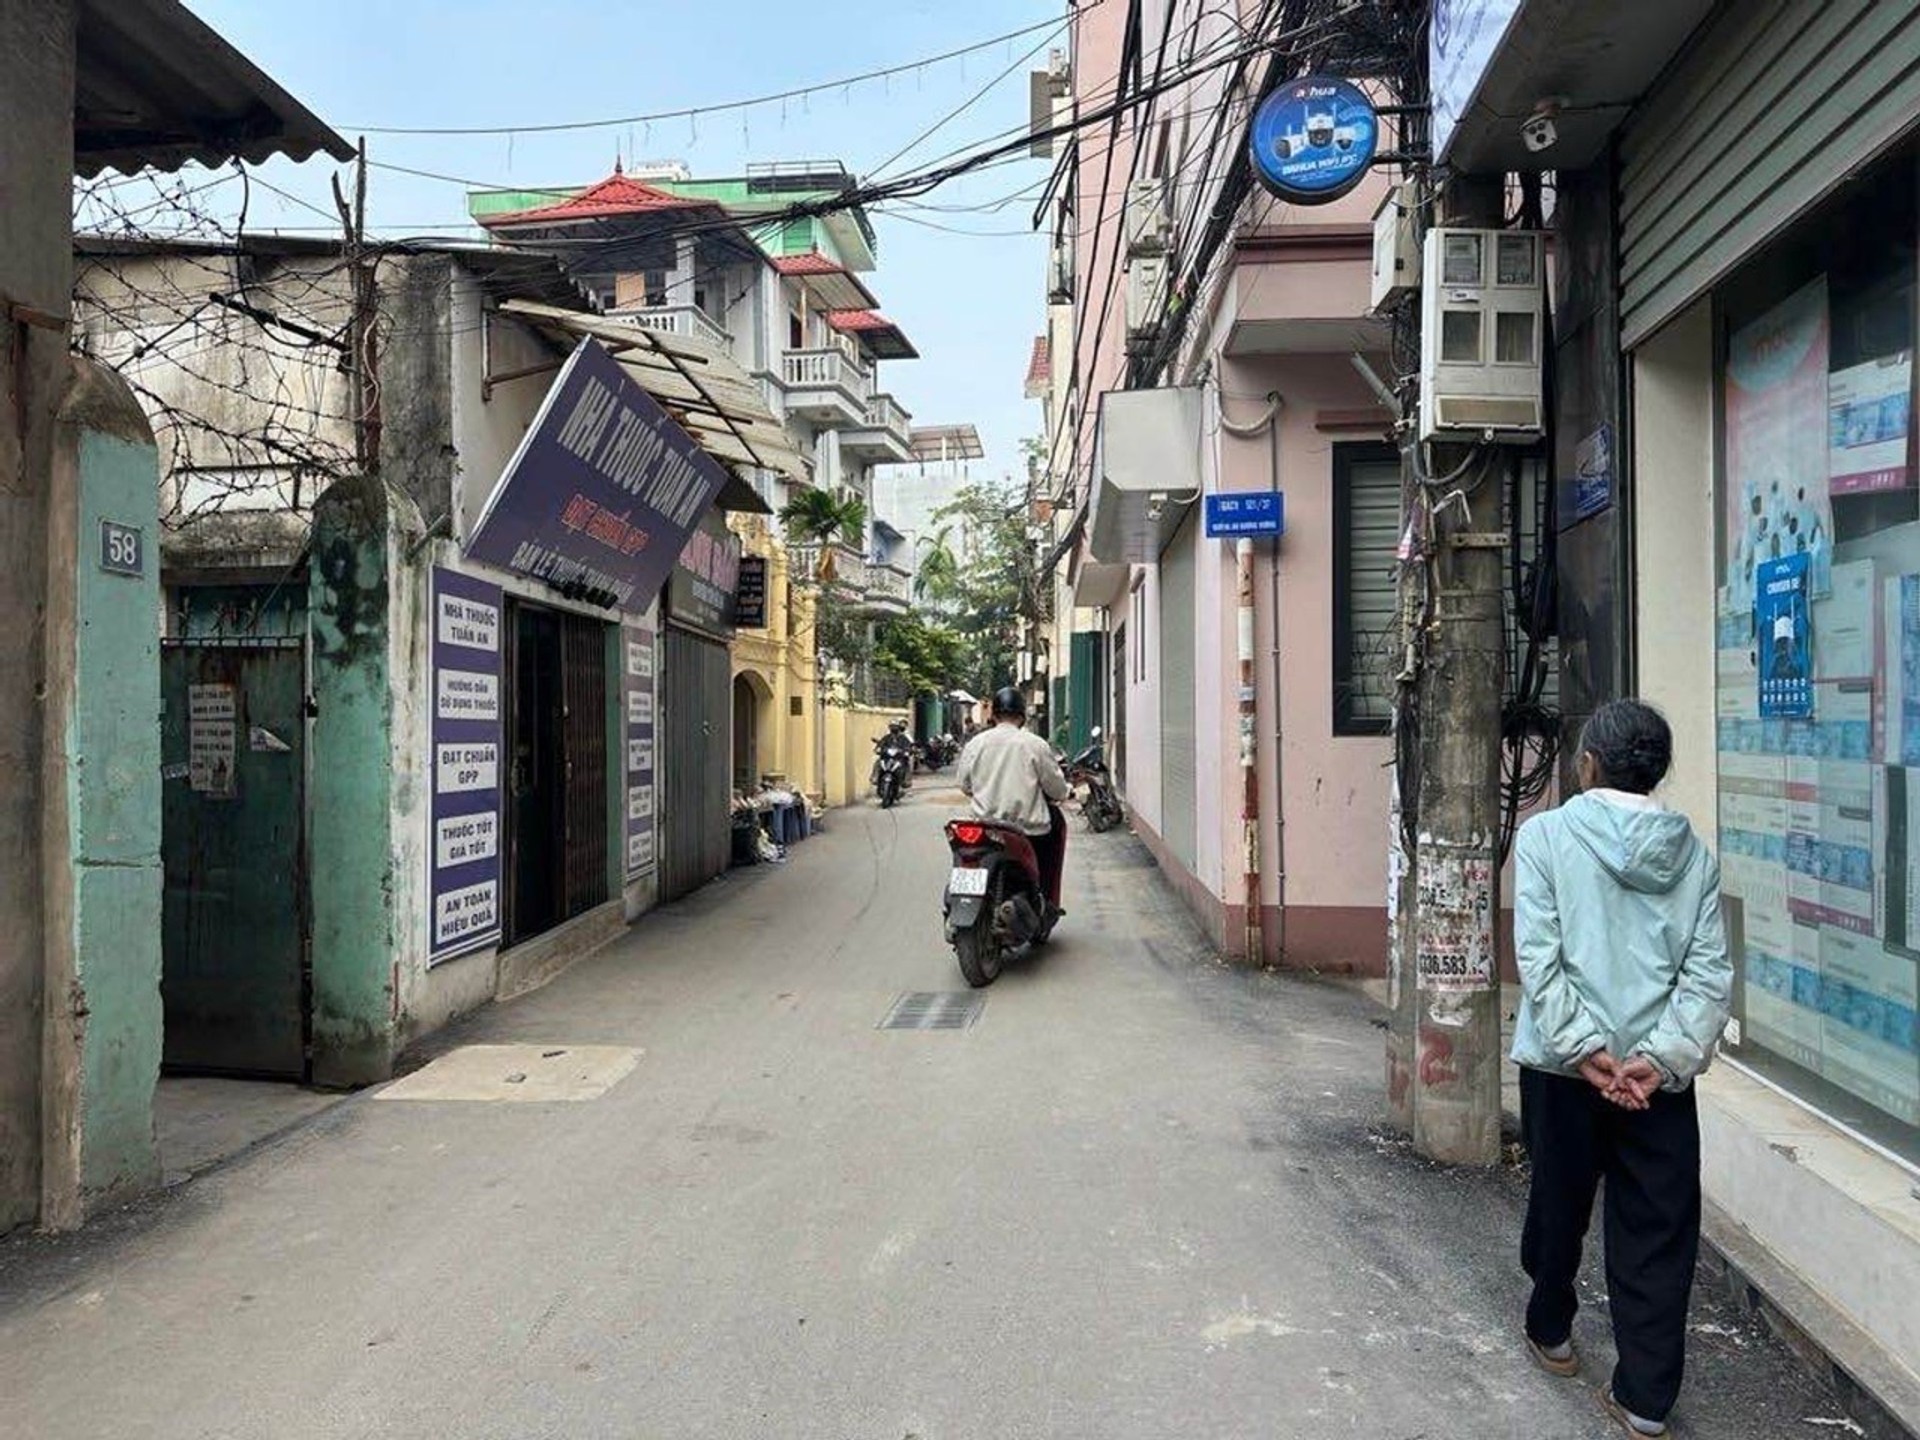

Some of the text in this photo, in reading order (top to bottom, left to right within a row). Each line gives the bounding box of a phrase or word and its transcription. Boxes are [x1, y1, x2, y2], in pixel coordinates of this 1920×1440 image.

[109, 530, 136, 565] 58
[444, 602, 496, 628] NHÀ THUỐC
[477, 631, 489, 645] AN
[458, 770, 479, 785] GPP
[442, 819, 493, 841] THUỐC TỐT
[450, 840, 487, 861] GIÁ TỐT
[445, 888, 493, 914] AN TOÀN
[441, 907, 493, 937] HIỆU QUẢ
